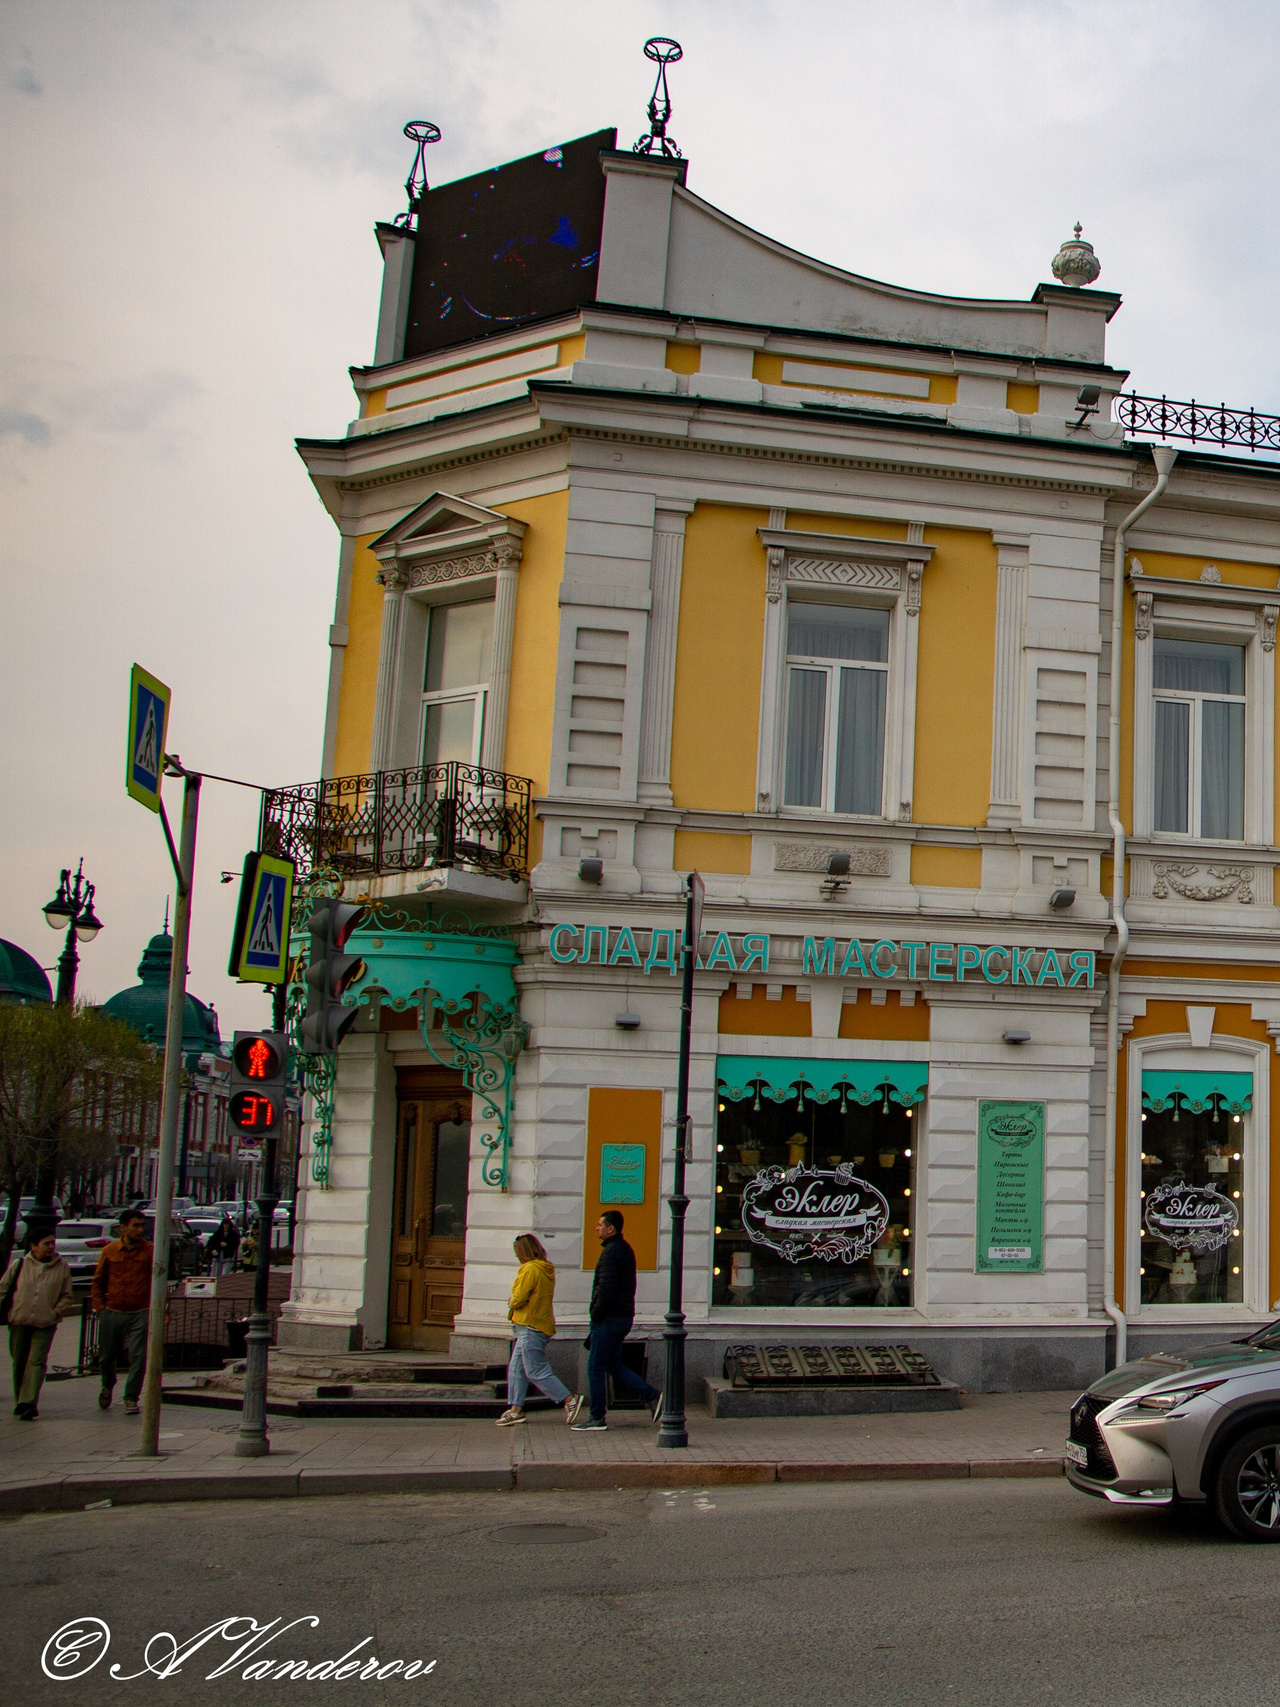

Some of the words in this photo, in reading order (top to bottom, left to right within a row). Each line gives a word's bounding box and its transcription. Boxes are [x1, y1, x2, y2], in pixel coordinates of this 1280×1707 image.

[802, 935, 1095, 989] МАСТЕРСКАЯ
[240, 1096, 272, 1126] 37
[998, 1119, 1027, 1132] Эклер
[1002, 1151, 1023, 1159] Торты
[993, 1161, 1029, 1169] Пирожные
[996, 1171, 1026, 1179] Десерты
[774, 1181, 860, 1217] Эклер
[996, 1191, 1026, 1199] Кофе-бар
[1165, 1194, 1220, 1219] Эклер
[775, 1219, 808, 1228] сладкая
[809, 1217, 857, 1228] мастерская
